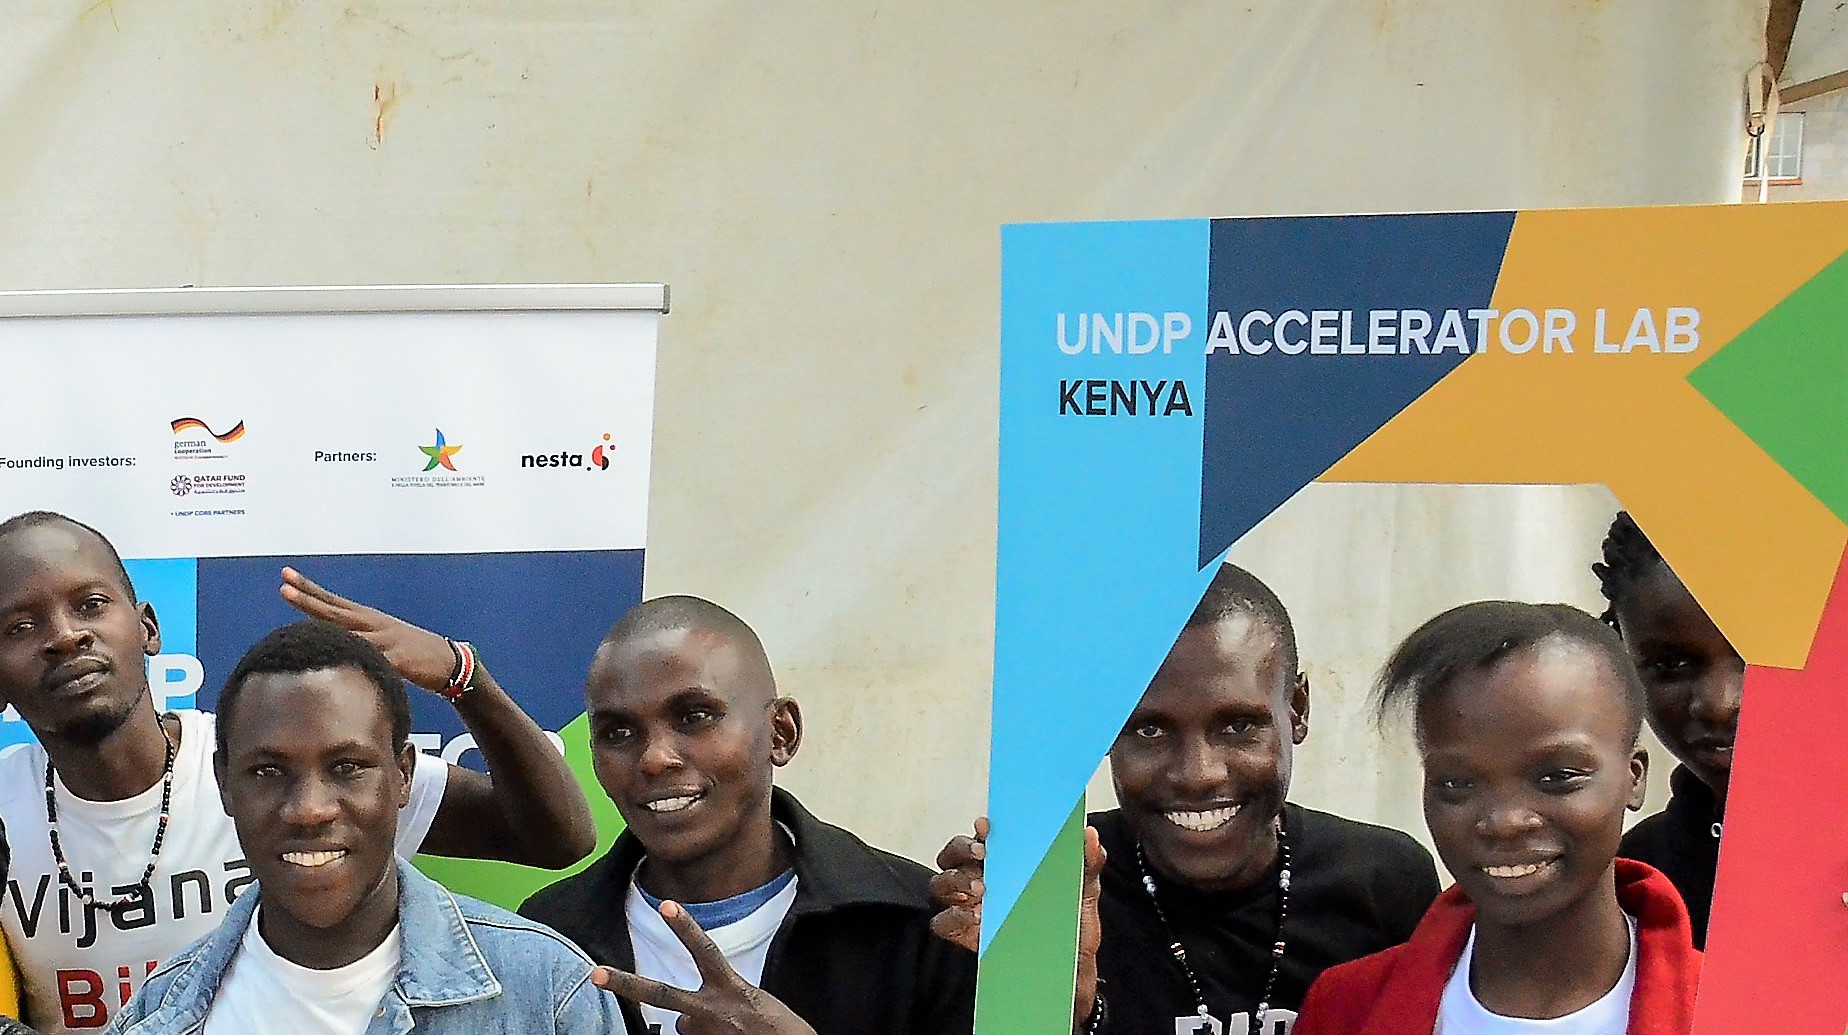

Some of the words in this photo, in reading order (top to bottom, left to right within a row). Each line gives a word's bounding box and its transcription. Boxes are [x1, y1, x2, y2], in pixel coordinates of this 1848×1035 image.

[1057, 311, 1192, 356] UNDP
[1206, 308, 1576, 356] ACCELERATOR
[1593, 307, 1701, 354] LAB
[1058, 379, 1194, 417] KENYA
[68, 455, 136, 467] investors:
[314, 450, 377, 462] Partners:
[521, 451, 583, 467] nesta
[8, 859, 253, 948] Vijana
